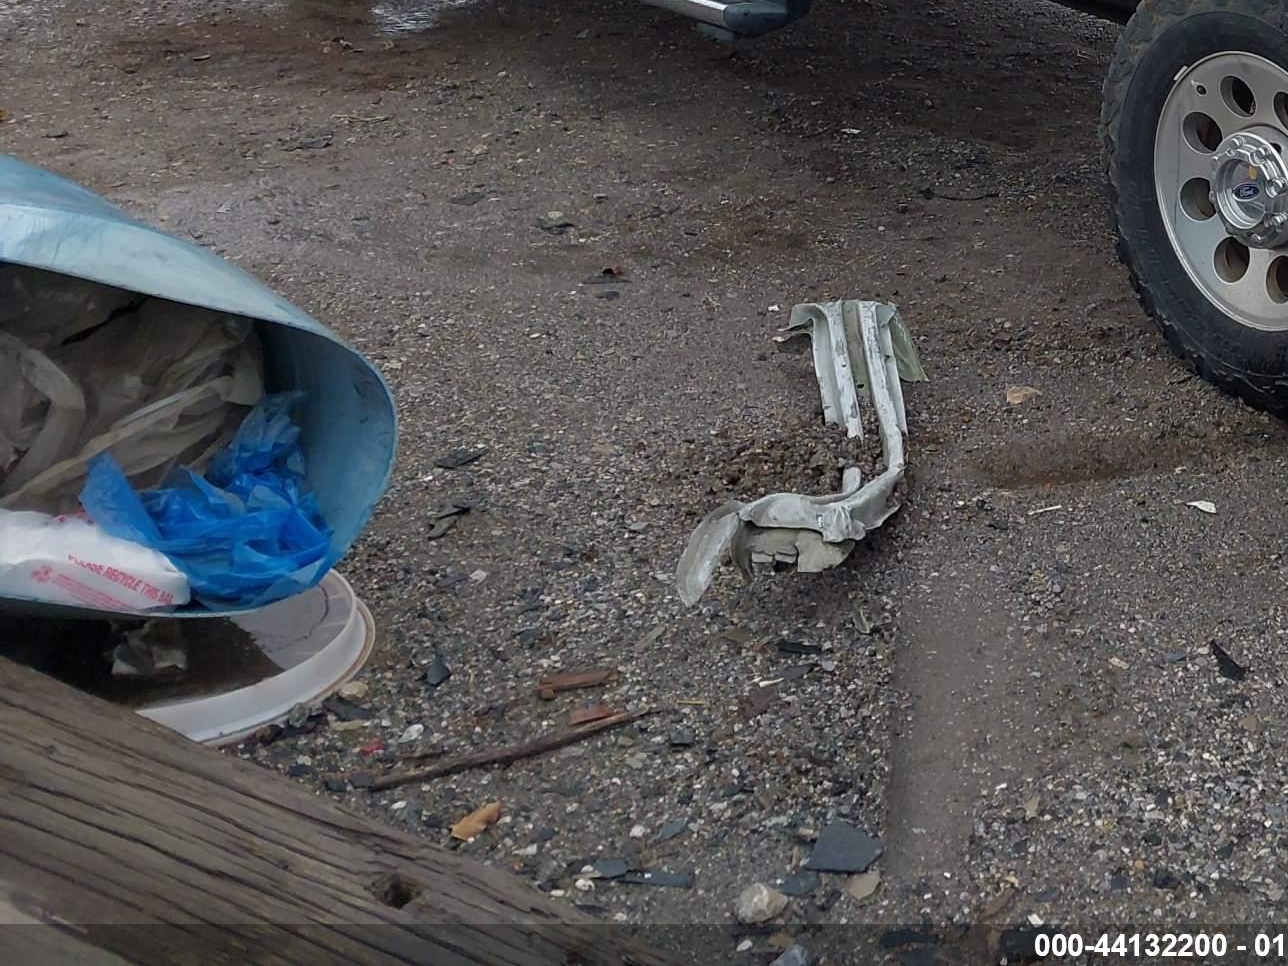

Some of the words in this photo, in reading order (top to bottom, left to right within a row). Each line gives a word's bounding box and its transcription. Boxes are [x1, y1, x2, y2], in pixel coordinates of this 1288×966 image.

[68, 554, 104, 576] PLEASE
[103, 566, 142, 592] RECYCLE
[140, 582, 161, 601] THIS
